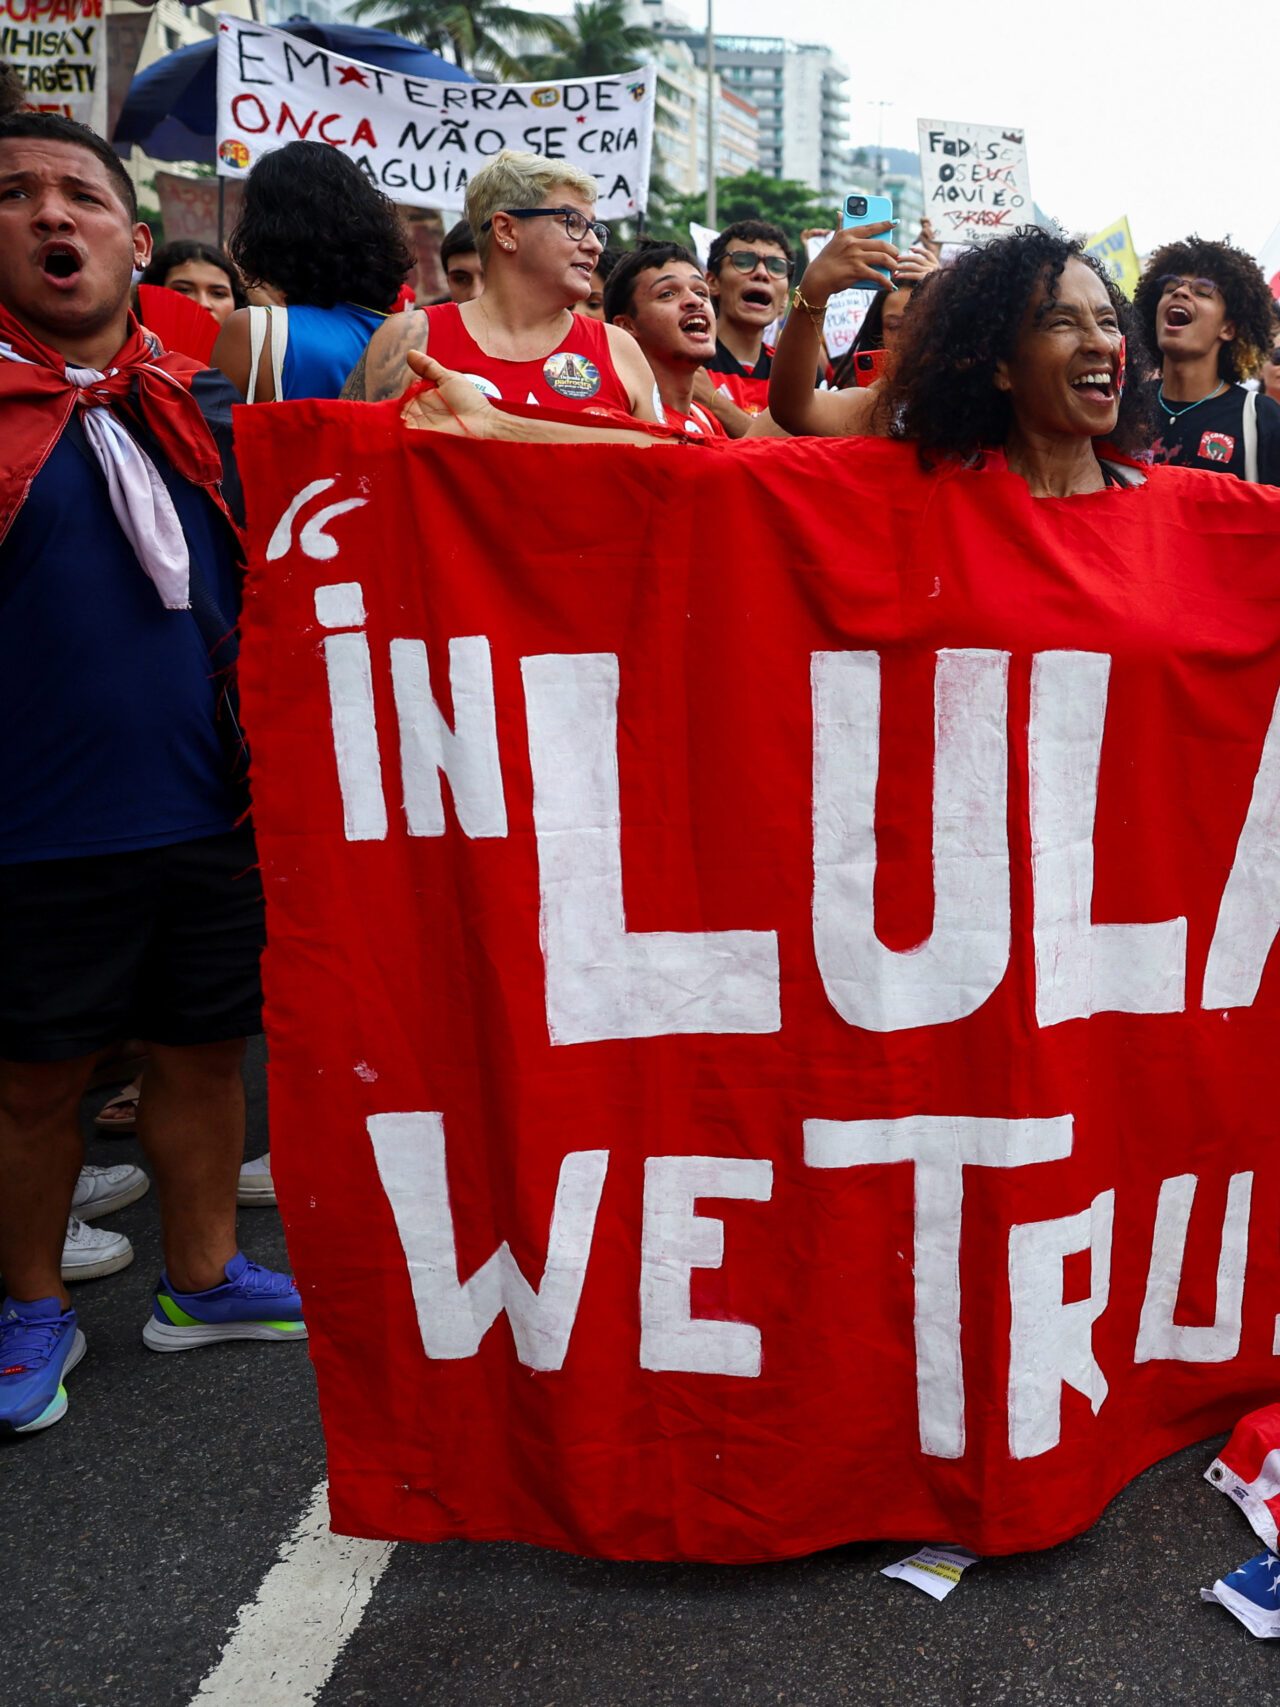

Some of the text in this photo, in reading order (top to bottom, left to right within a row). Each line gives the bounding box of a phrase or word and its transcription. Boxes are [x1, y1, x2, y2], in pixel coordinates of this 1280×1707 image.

[238, 30, 622, 111] EM TERRA DE
[231, 93, 378, 149] ONÇA
[398, 120, 506, 155] NÃO
[523, 127, 568, 159] SE
[366, 1110, 774, 1379] WE
